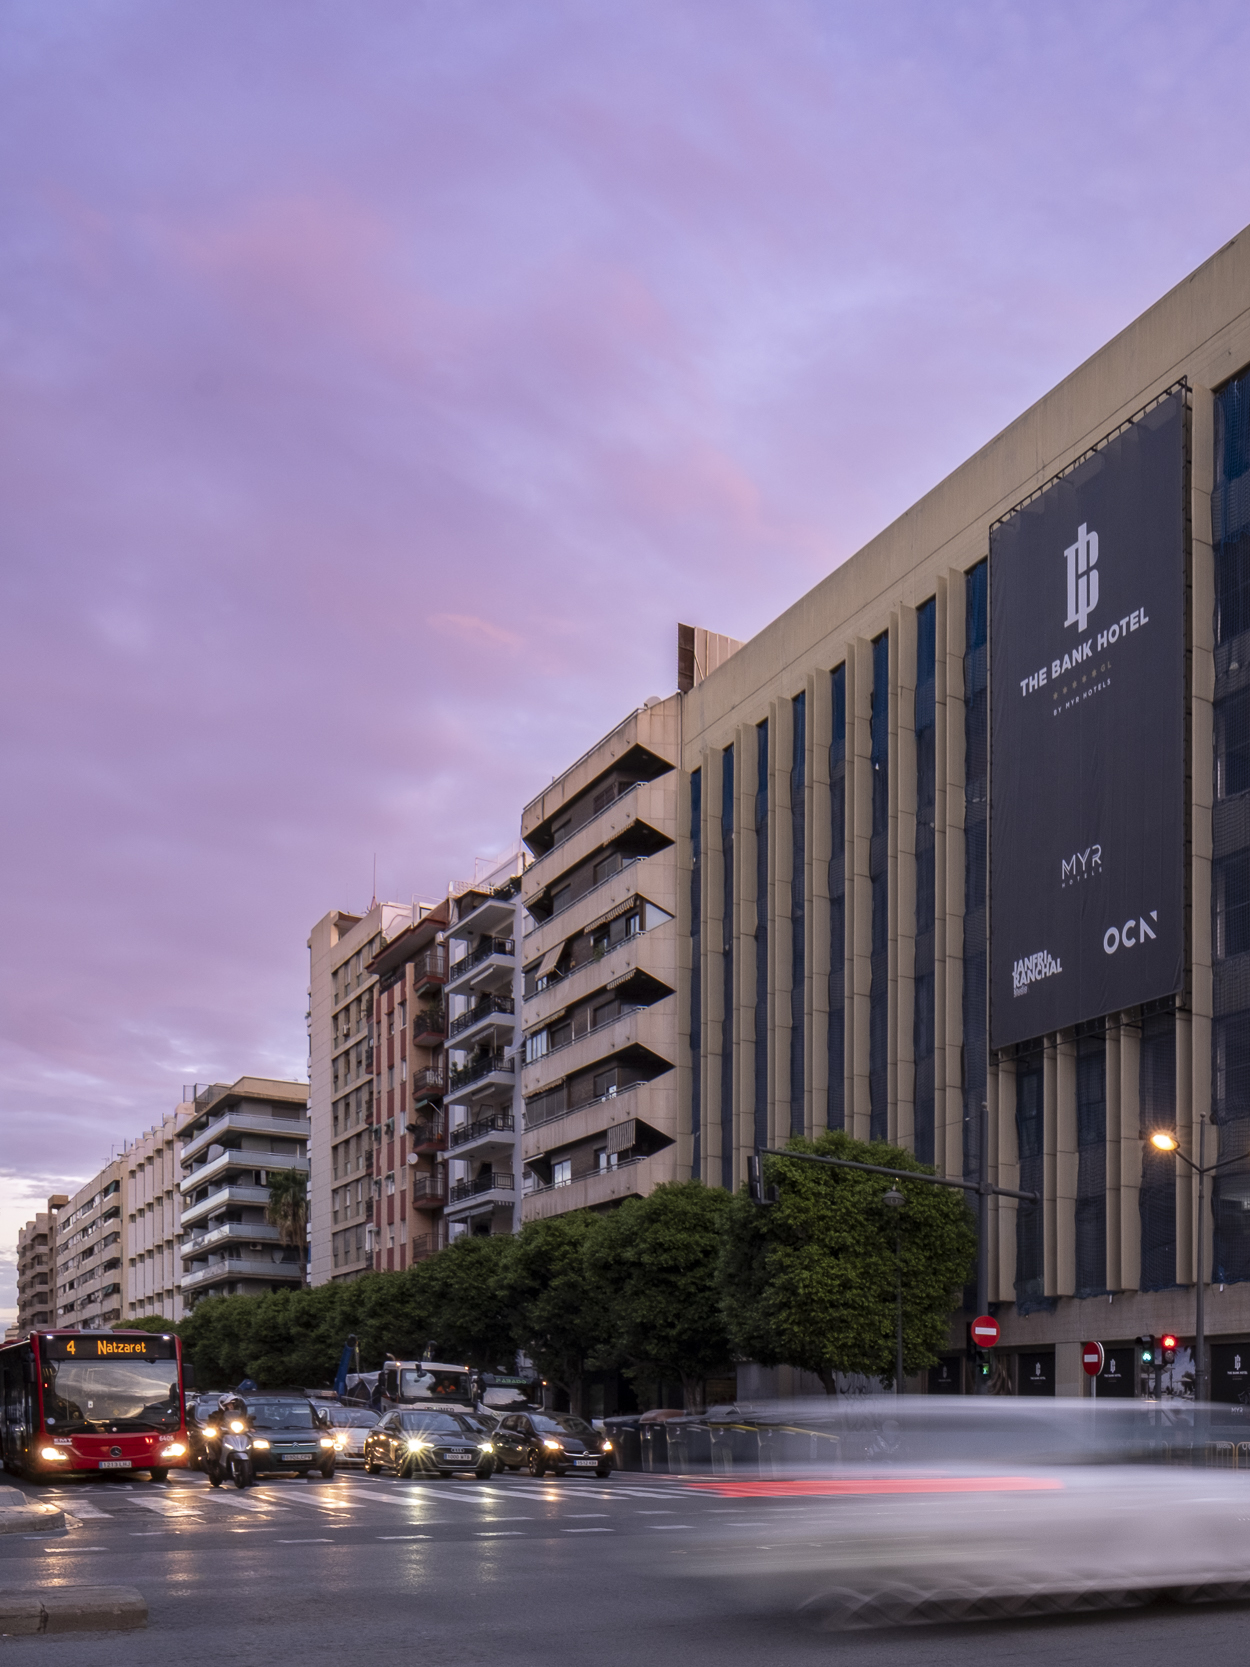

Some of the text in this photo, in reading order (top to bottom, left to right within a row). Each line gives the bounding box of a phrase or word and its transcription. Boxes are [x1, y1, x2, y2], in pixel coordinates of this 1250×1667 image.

[1020, 606, 1150, 697] THE BANK HOTEL
[1053, 678, 1112, 717] BY MYR HOTELS
[1062, 844, 1102, 880] MYR
[1062, 866, 1102, 888] HOTELS
[1014, 958, 1062, 988] RANCHAL
[66, 1340, 147, 1355] 4 Natzaret
